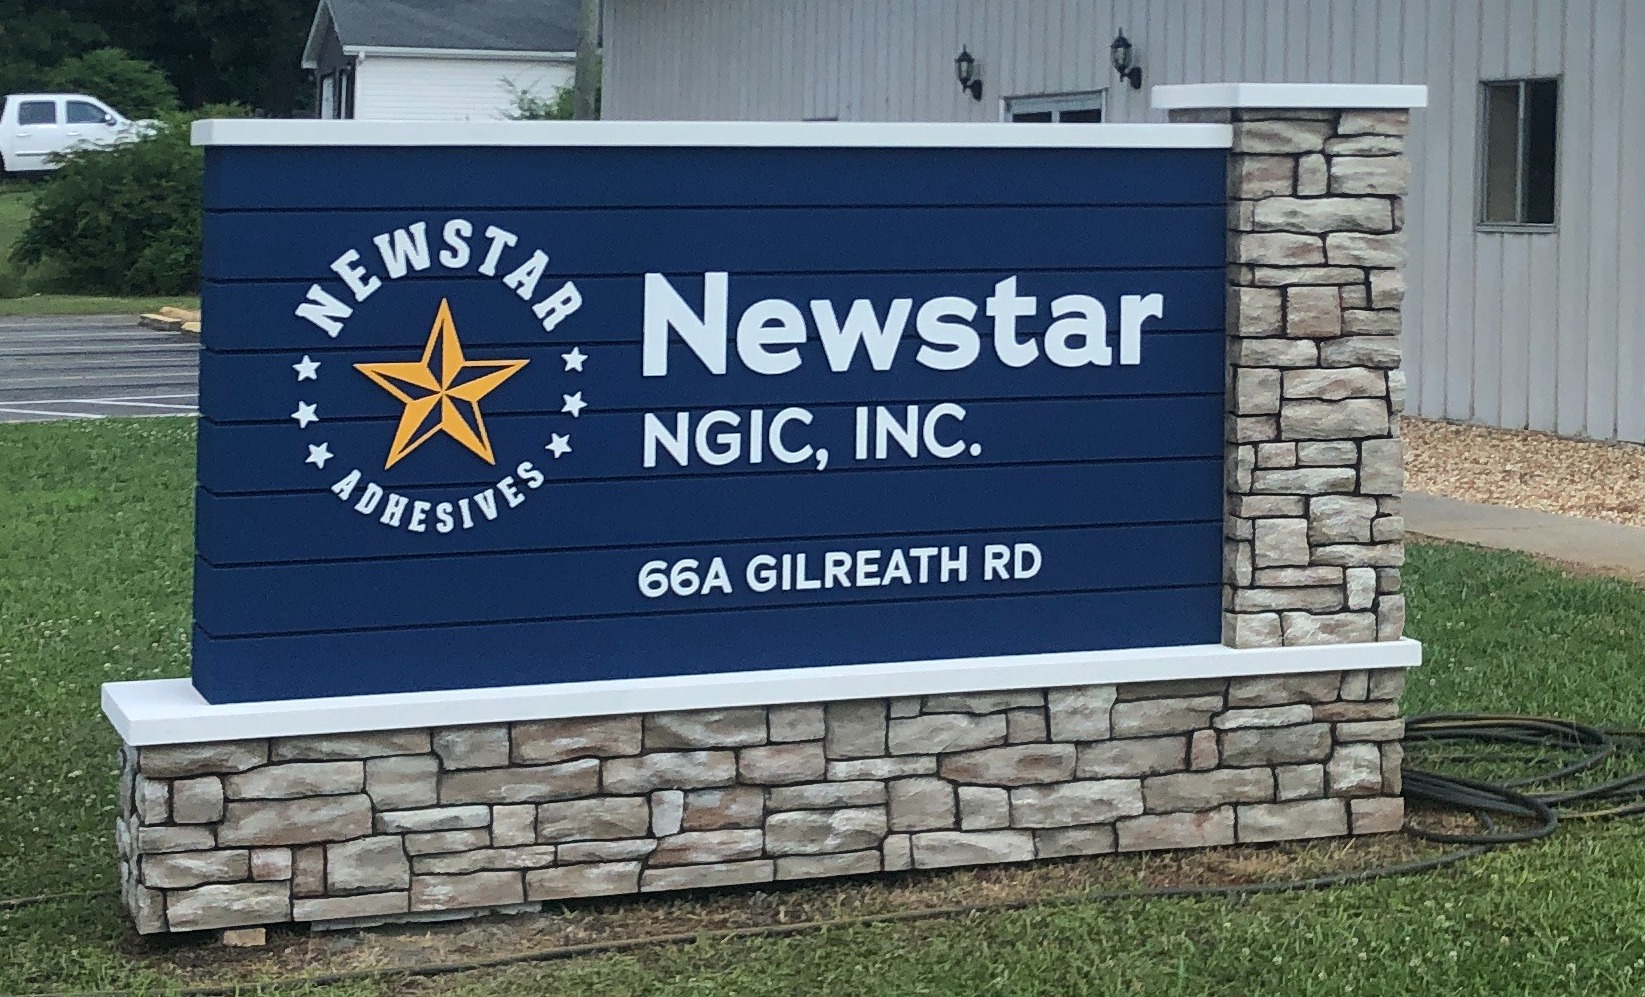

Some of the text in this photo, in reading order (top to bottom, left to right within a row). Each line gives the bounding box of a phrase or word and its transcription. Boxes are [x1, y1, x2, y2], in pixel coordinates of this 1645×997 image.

[295, 218, 583, 338] NEWSTAR
[642, 271, 1165, 377] Newstar
[643, 402, 982, 471] NGIC, INC.
[331, 461, 545, 533] ADHESIVES
[638, 543, 1042, 599] 66A GILREATH RD
